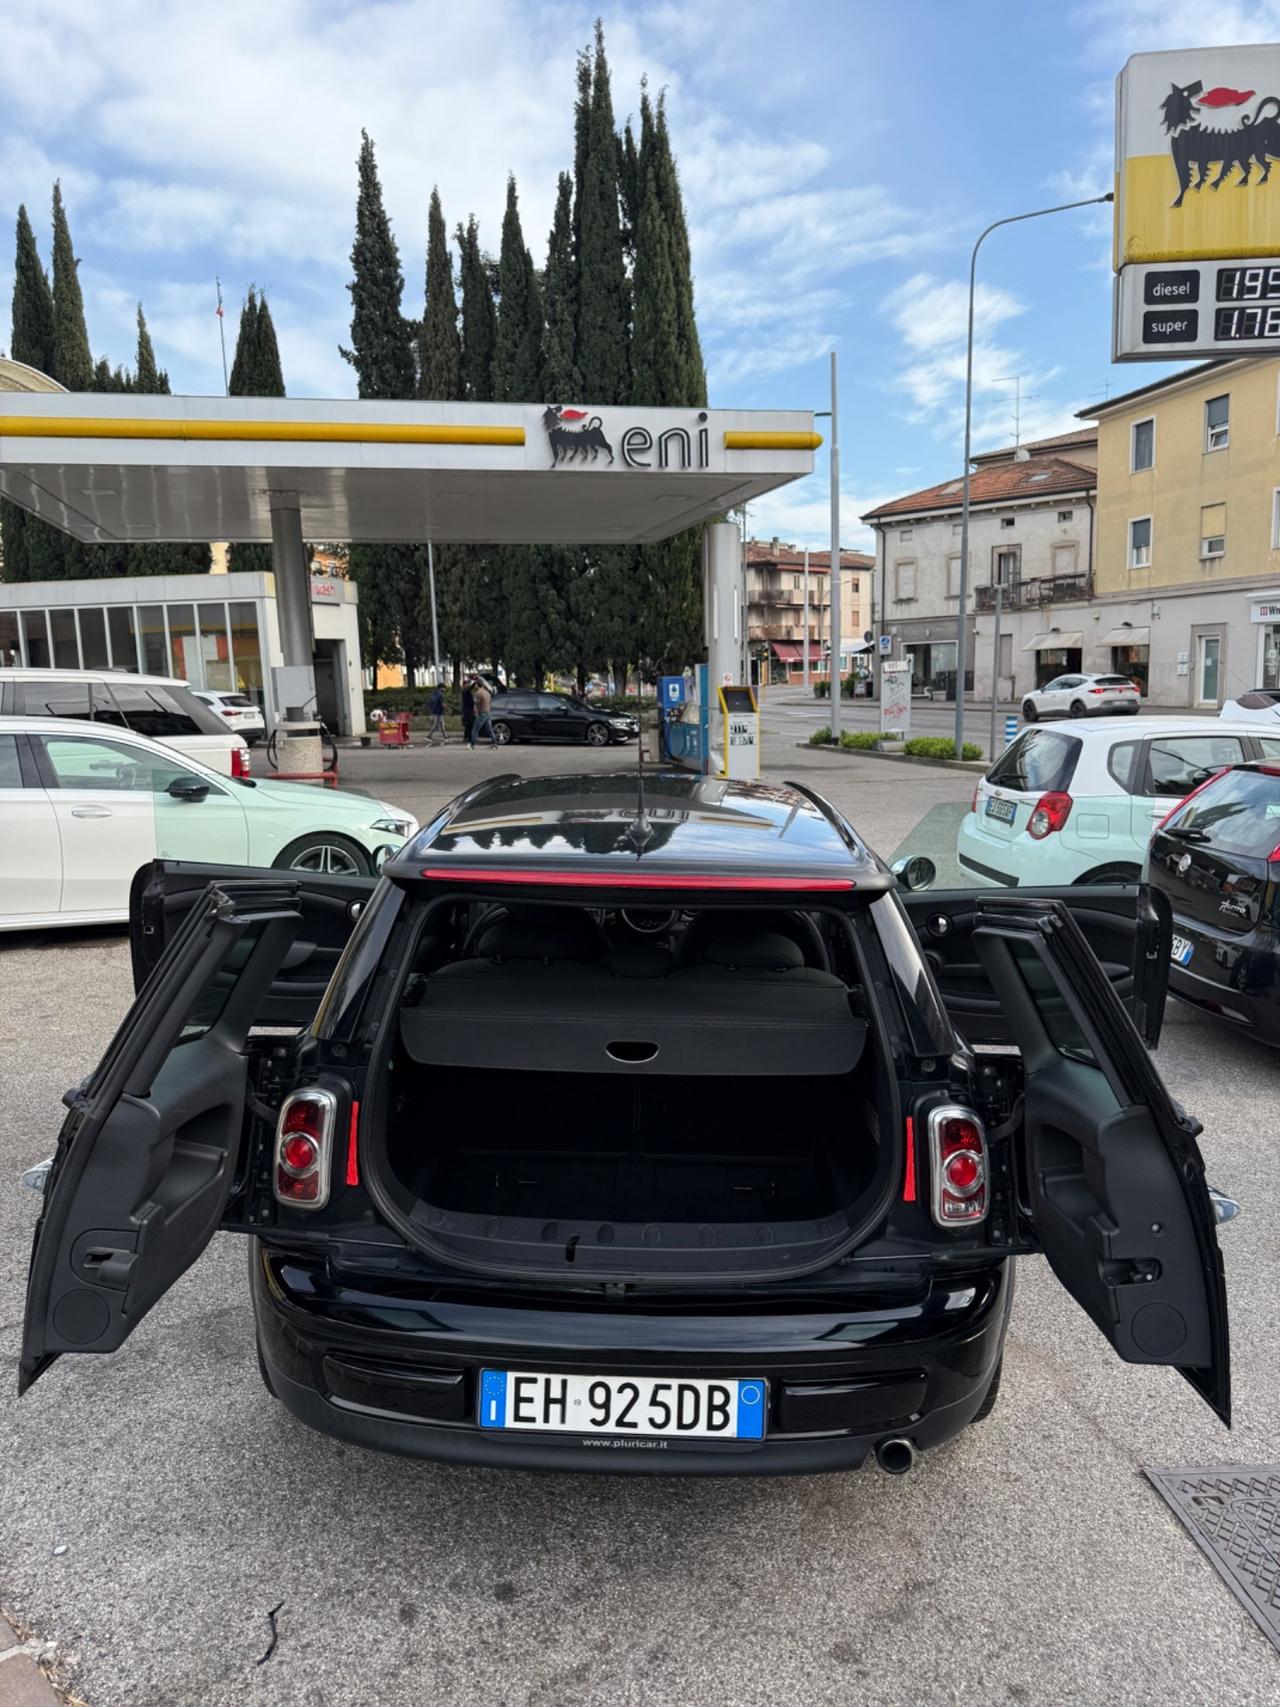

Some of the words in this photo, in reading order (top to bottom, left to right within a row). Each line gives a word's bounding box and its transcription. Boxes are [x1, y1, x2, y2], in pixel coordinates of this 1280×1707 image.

[1152, 281, 1190, 296] diesel
[1151, 321, 1188, 335] super
[621, 411, 709, 468] eni
[513, 1376, 569, 1425] EH
[588, 1380, 732, 1432] 925DB
[582, 1439, 669, 1449] www.pluricar.it
